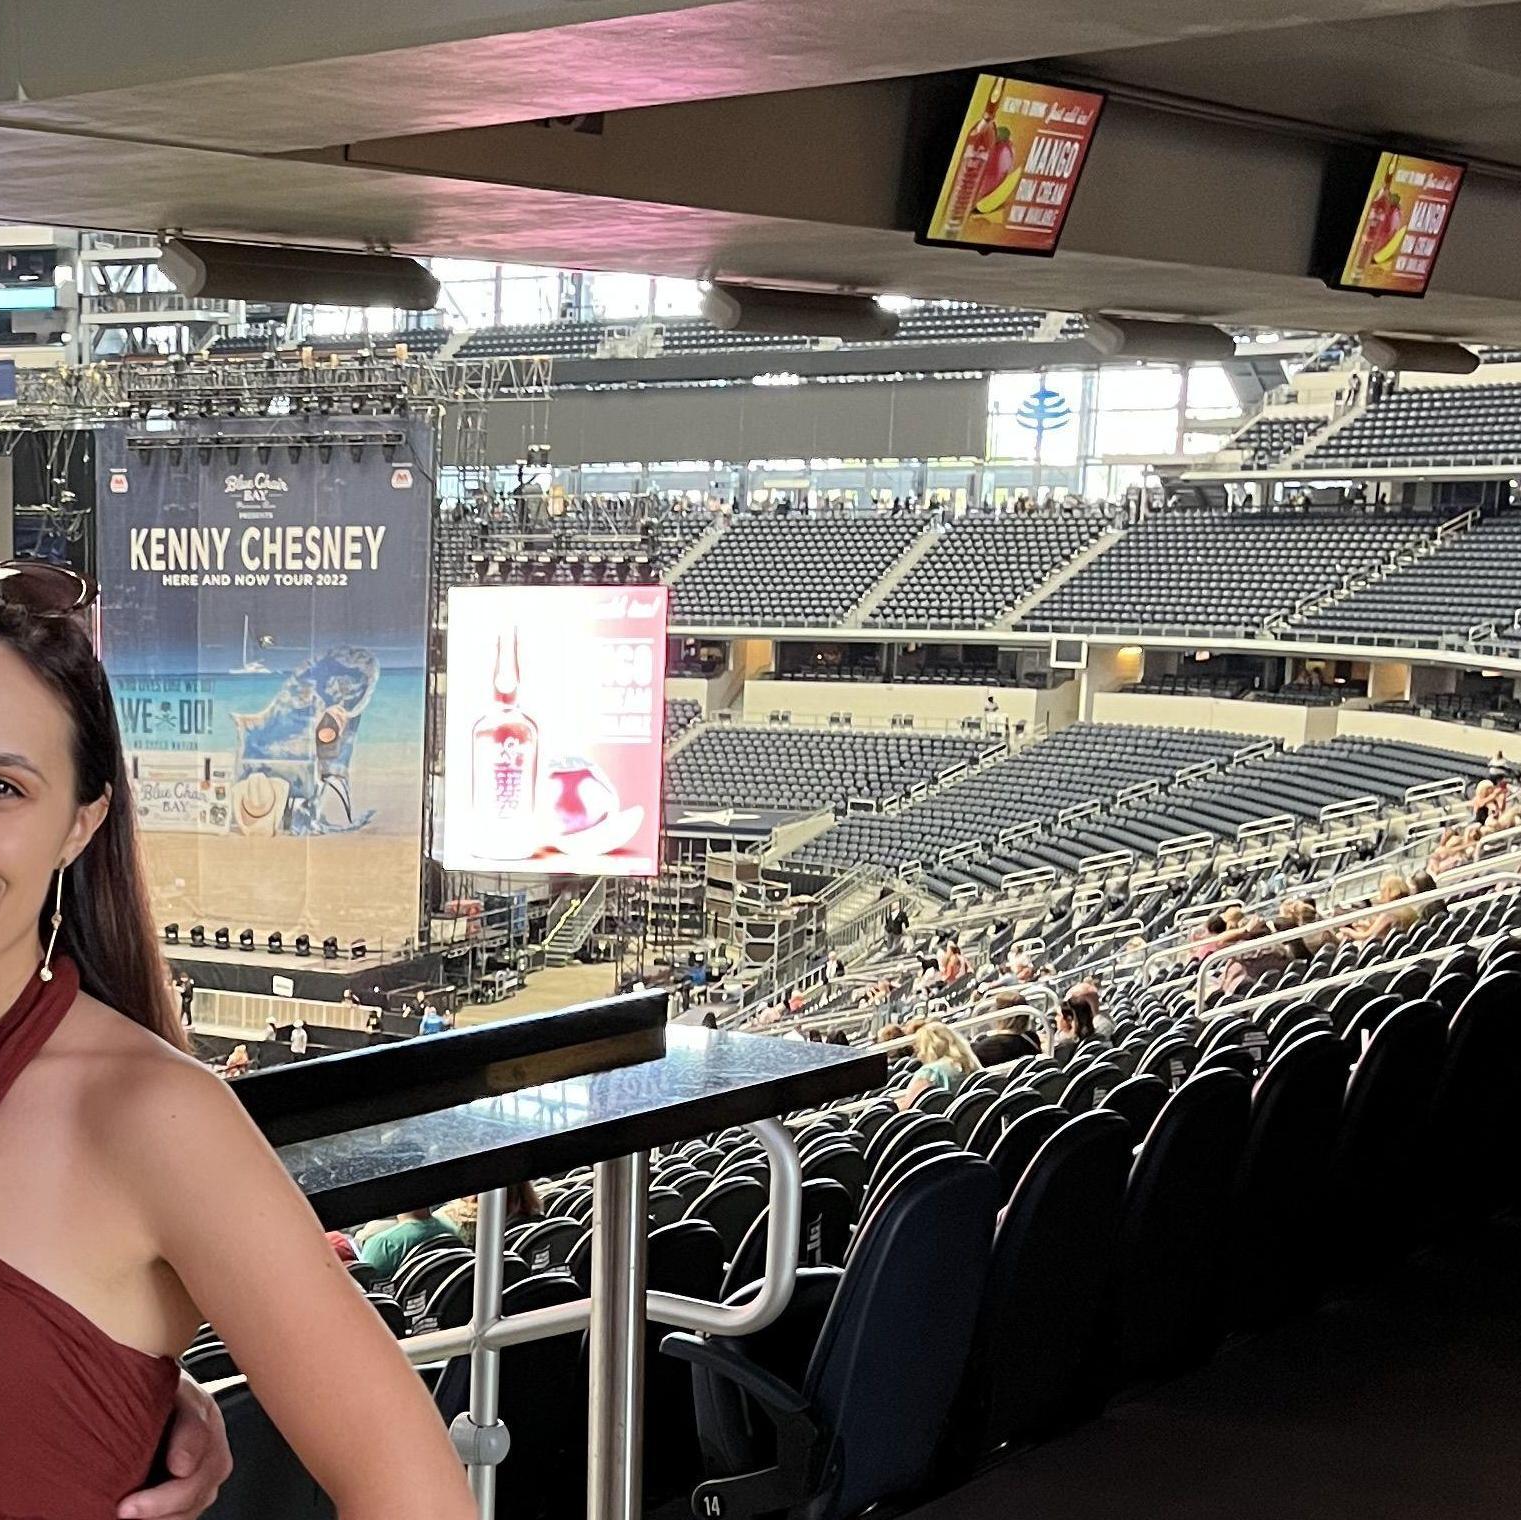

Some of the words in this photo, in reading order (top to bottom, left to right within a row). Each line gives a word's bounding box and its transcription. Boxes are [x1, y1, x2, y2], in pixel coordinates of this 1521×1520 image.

[130, 527, 231, 571] KENNY
[240, 525, 386, 571] CHESNEY
[162, 574, 199, 586] HERE
[201, 574, 231, 586] AND
[235, 574, 270, 586] NOW
[275, 574, 313, 586] TOUR
[316, 573, 348, 586] 2022
[120, 697, 153, 734] WE
[179, 698, 213, 735] DO!
[162, 801, 188, 813] BAY
[703, 1496, 720, 1516] 14
